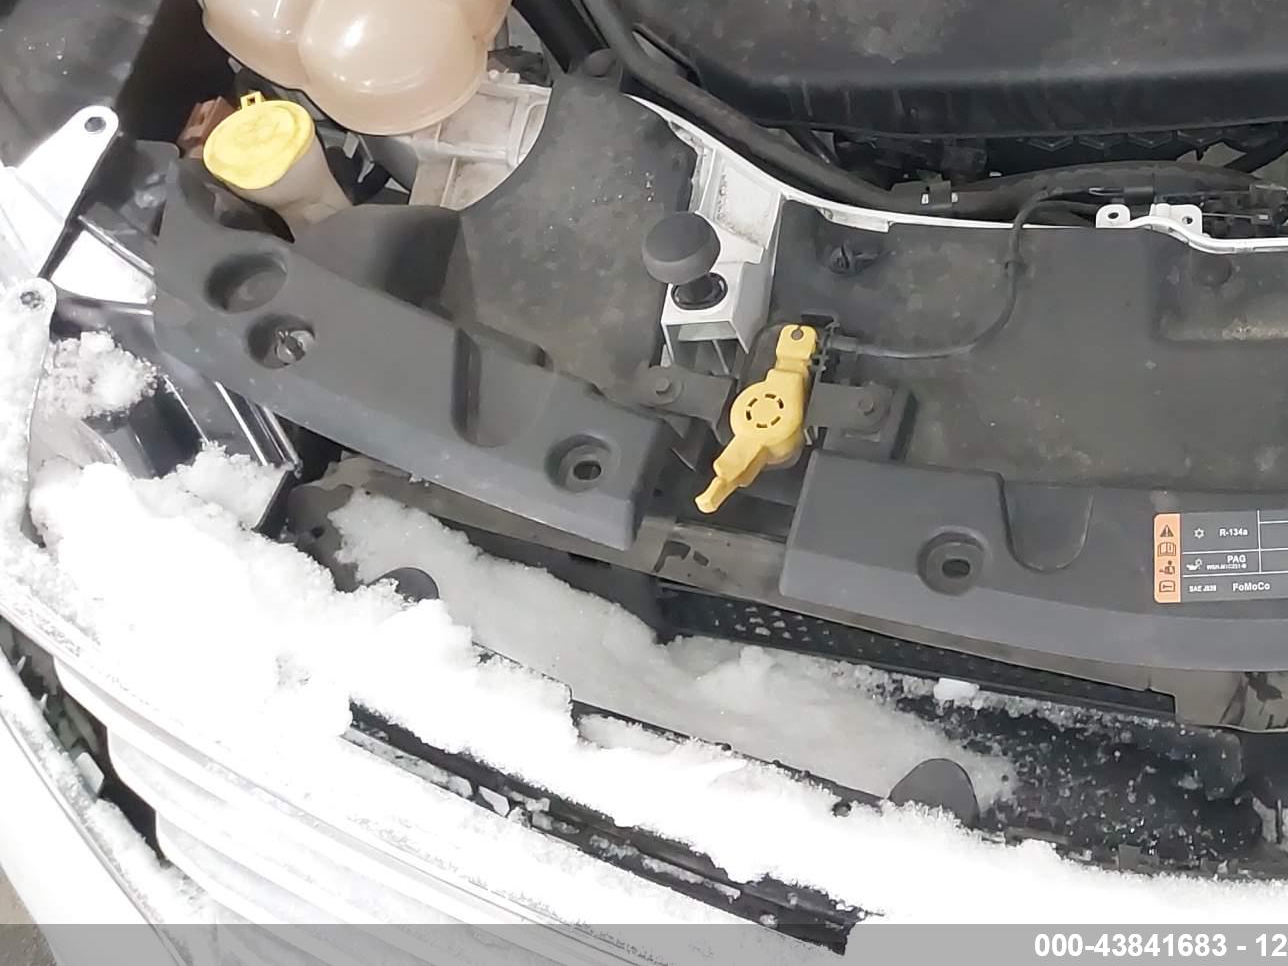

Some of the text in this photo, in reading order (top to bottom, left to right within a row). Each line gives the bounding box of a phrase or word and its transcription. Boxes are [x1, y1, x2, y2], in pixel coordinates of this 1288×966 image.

[1219, 527, 1248, 537] R-134a
[1227, 554, 1247, 564] PAG
[1189, 585, 1202, 593] SAE
[1232, 581, 1271, 592] FoMoCo
